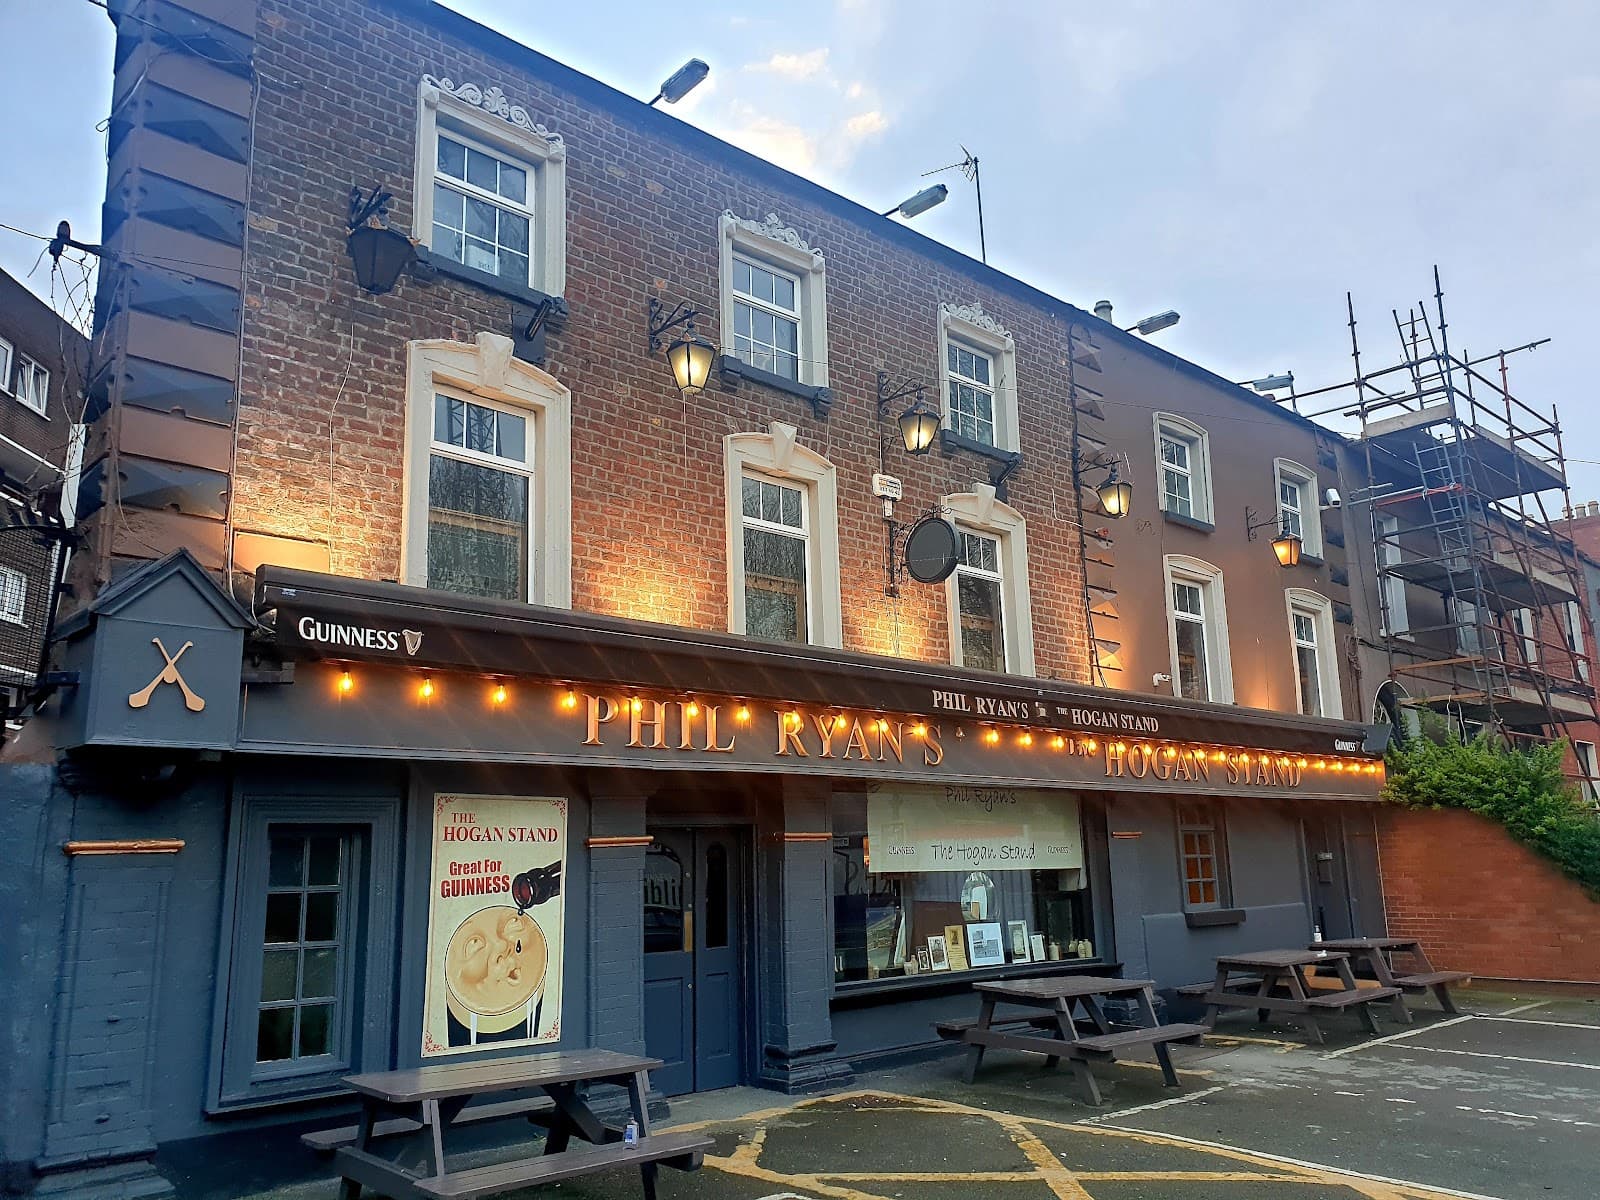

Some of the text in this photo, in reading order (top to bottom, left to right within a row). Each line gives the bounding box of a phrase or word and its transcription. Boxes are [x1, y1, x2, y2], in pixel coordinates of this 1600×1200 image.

[299, 616, 399, 651] GUINNESS
[932, 690, 1159, 733] PHIL RYAN'S THE HOGAN STAND
[581, 693, 736, 753] PHIL
[774, 709, 943, 766] RYANS
[1102, 740, 1209, 782] HOGAN
[1226, 752, 1301, 787] STAND
[452, 812, 476, 824] THE
[442, 826, 558, 842] HOGAN STAND
[931, 842, 1035, 865] The Hogan Stand
[450, 859, 502, 876] Great For
[440, 875, 510, 898] GUINNESS
